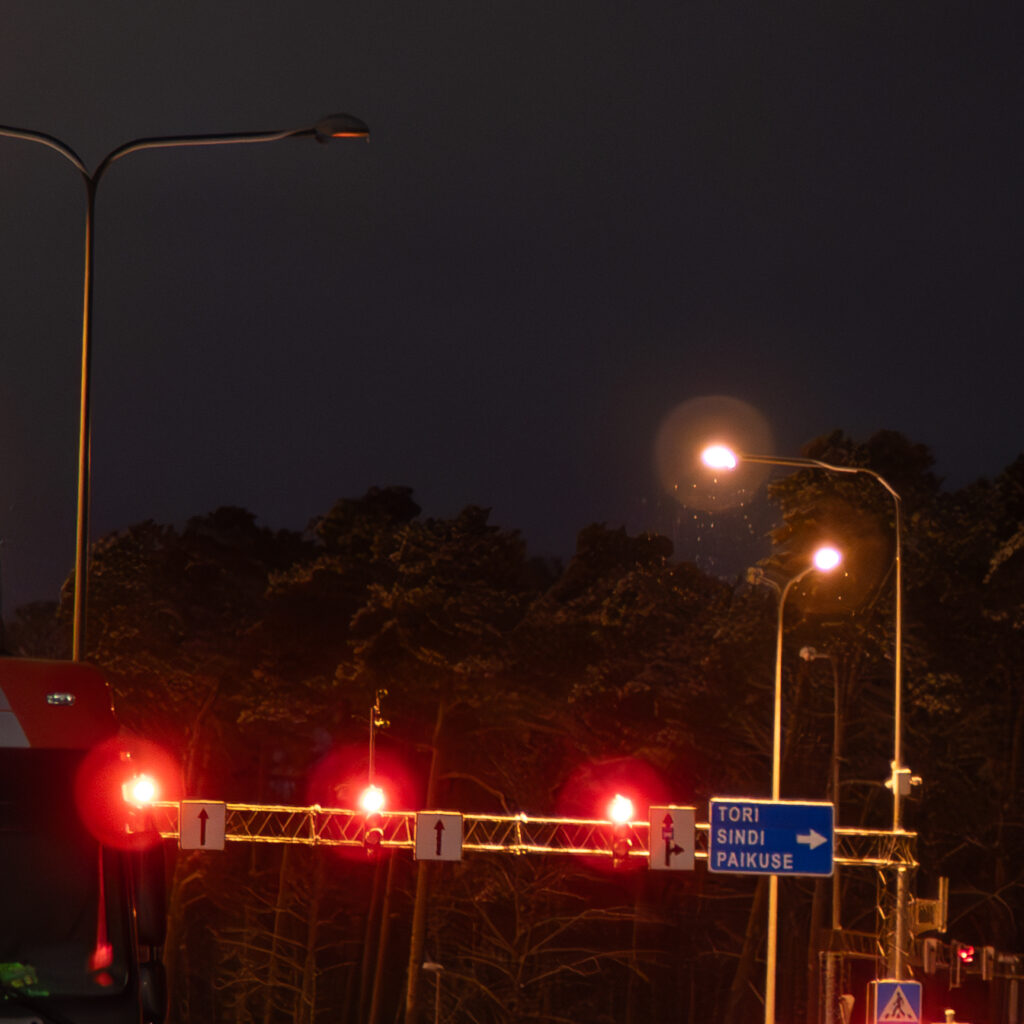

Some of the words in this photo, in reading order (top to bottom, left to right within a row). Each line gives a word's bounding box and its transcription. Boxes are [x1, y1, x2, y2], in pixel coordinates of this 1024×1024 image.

[718, 806, 759, 823] TORI
[716, 828, 765, 846] SINDI
[716, 851, 794, 870] PAIKUSE
